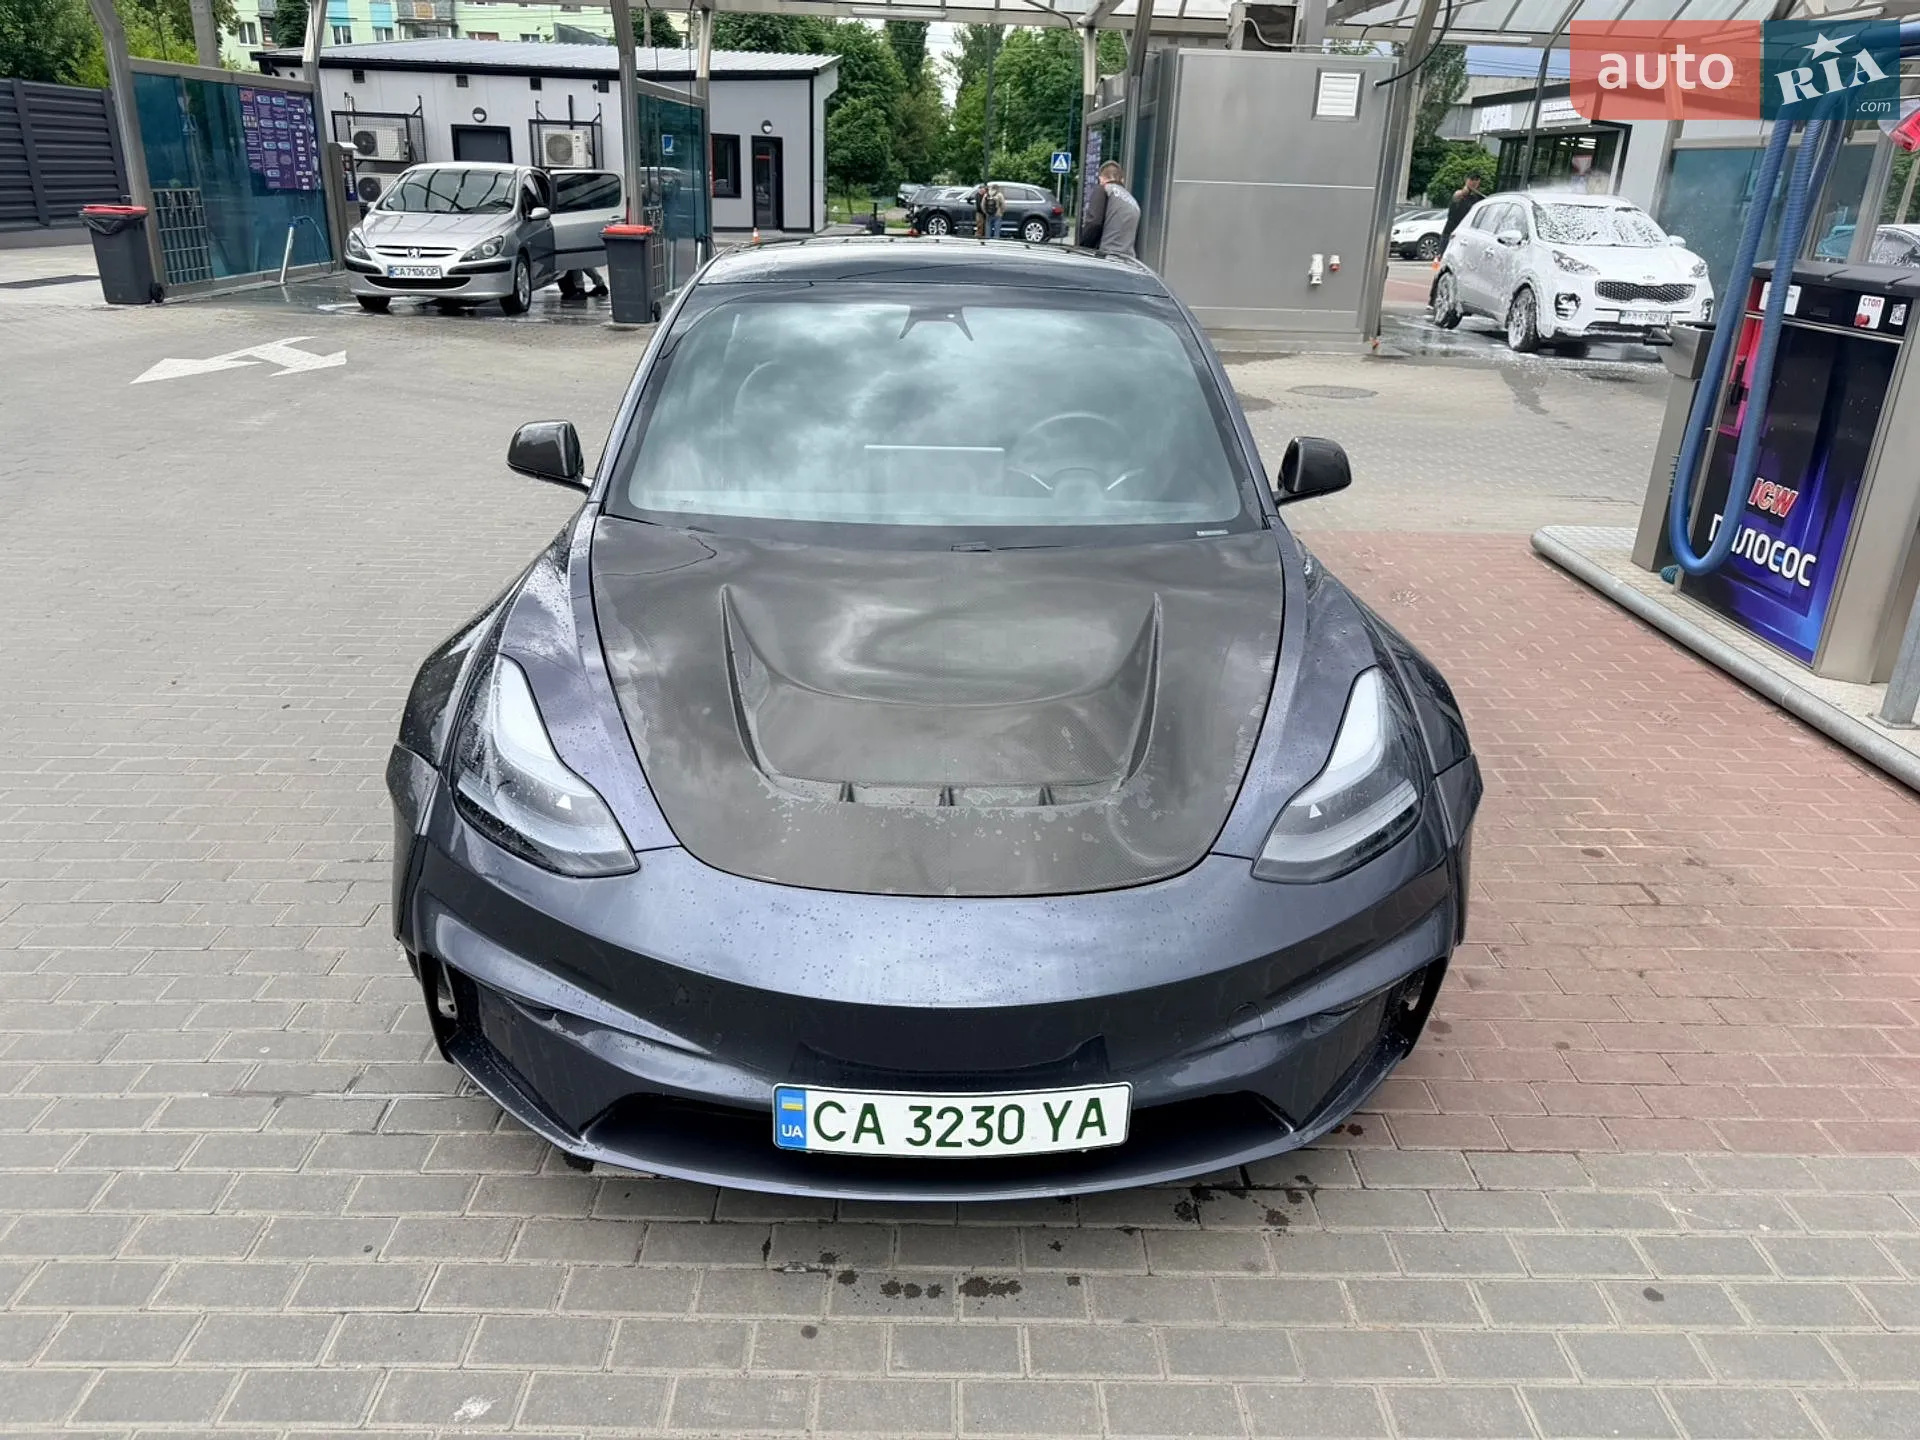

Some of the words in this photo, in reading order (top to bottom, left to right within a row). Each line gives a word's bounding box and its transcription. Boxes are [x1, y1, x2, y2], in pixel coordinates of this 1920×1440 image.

[1862, 297, 1881, 308] СТОП
[1748, 477, 1799, 518] ICW
[1708, 513, 1816, 587] ПЛОСОС
[782, 1123, 804, 1138] UA
[813, 1100, 885, 1145] CA
[905, 1105, 1025, 1148] 3230
[1042, 1097, 1107, 1142] YA
